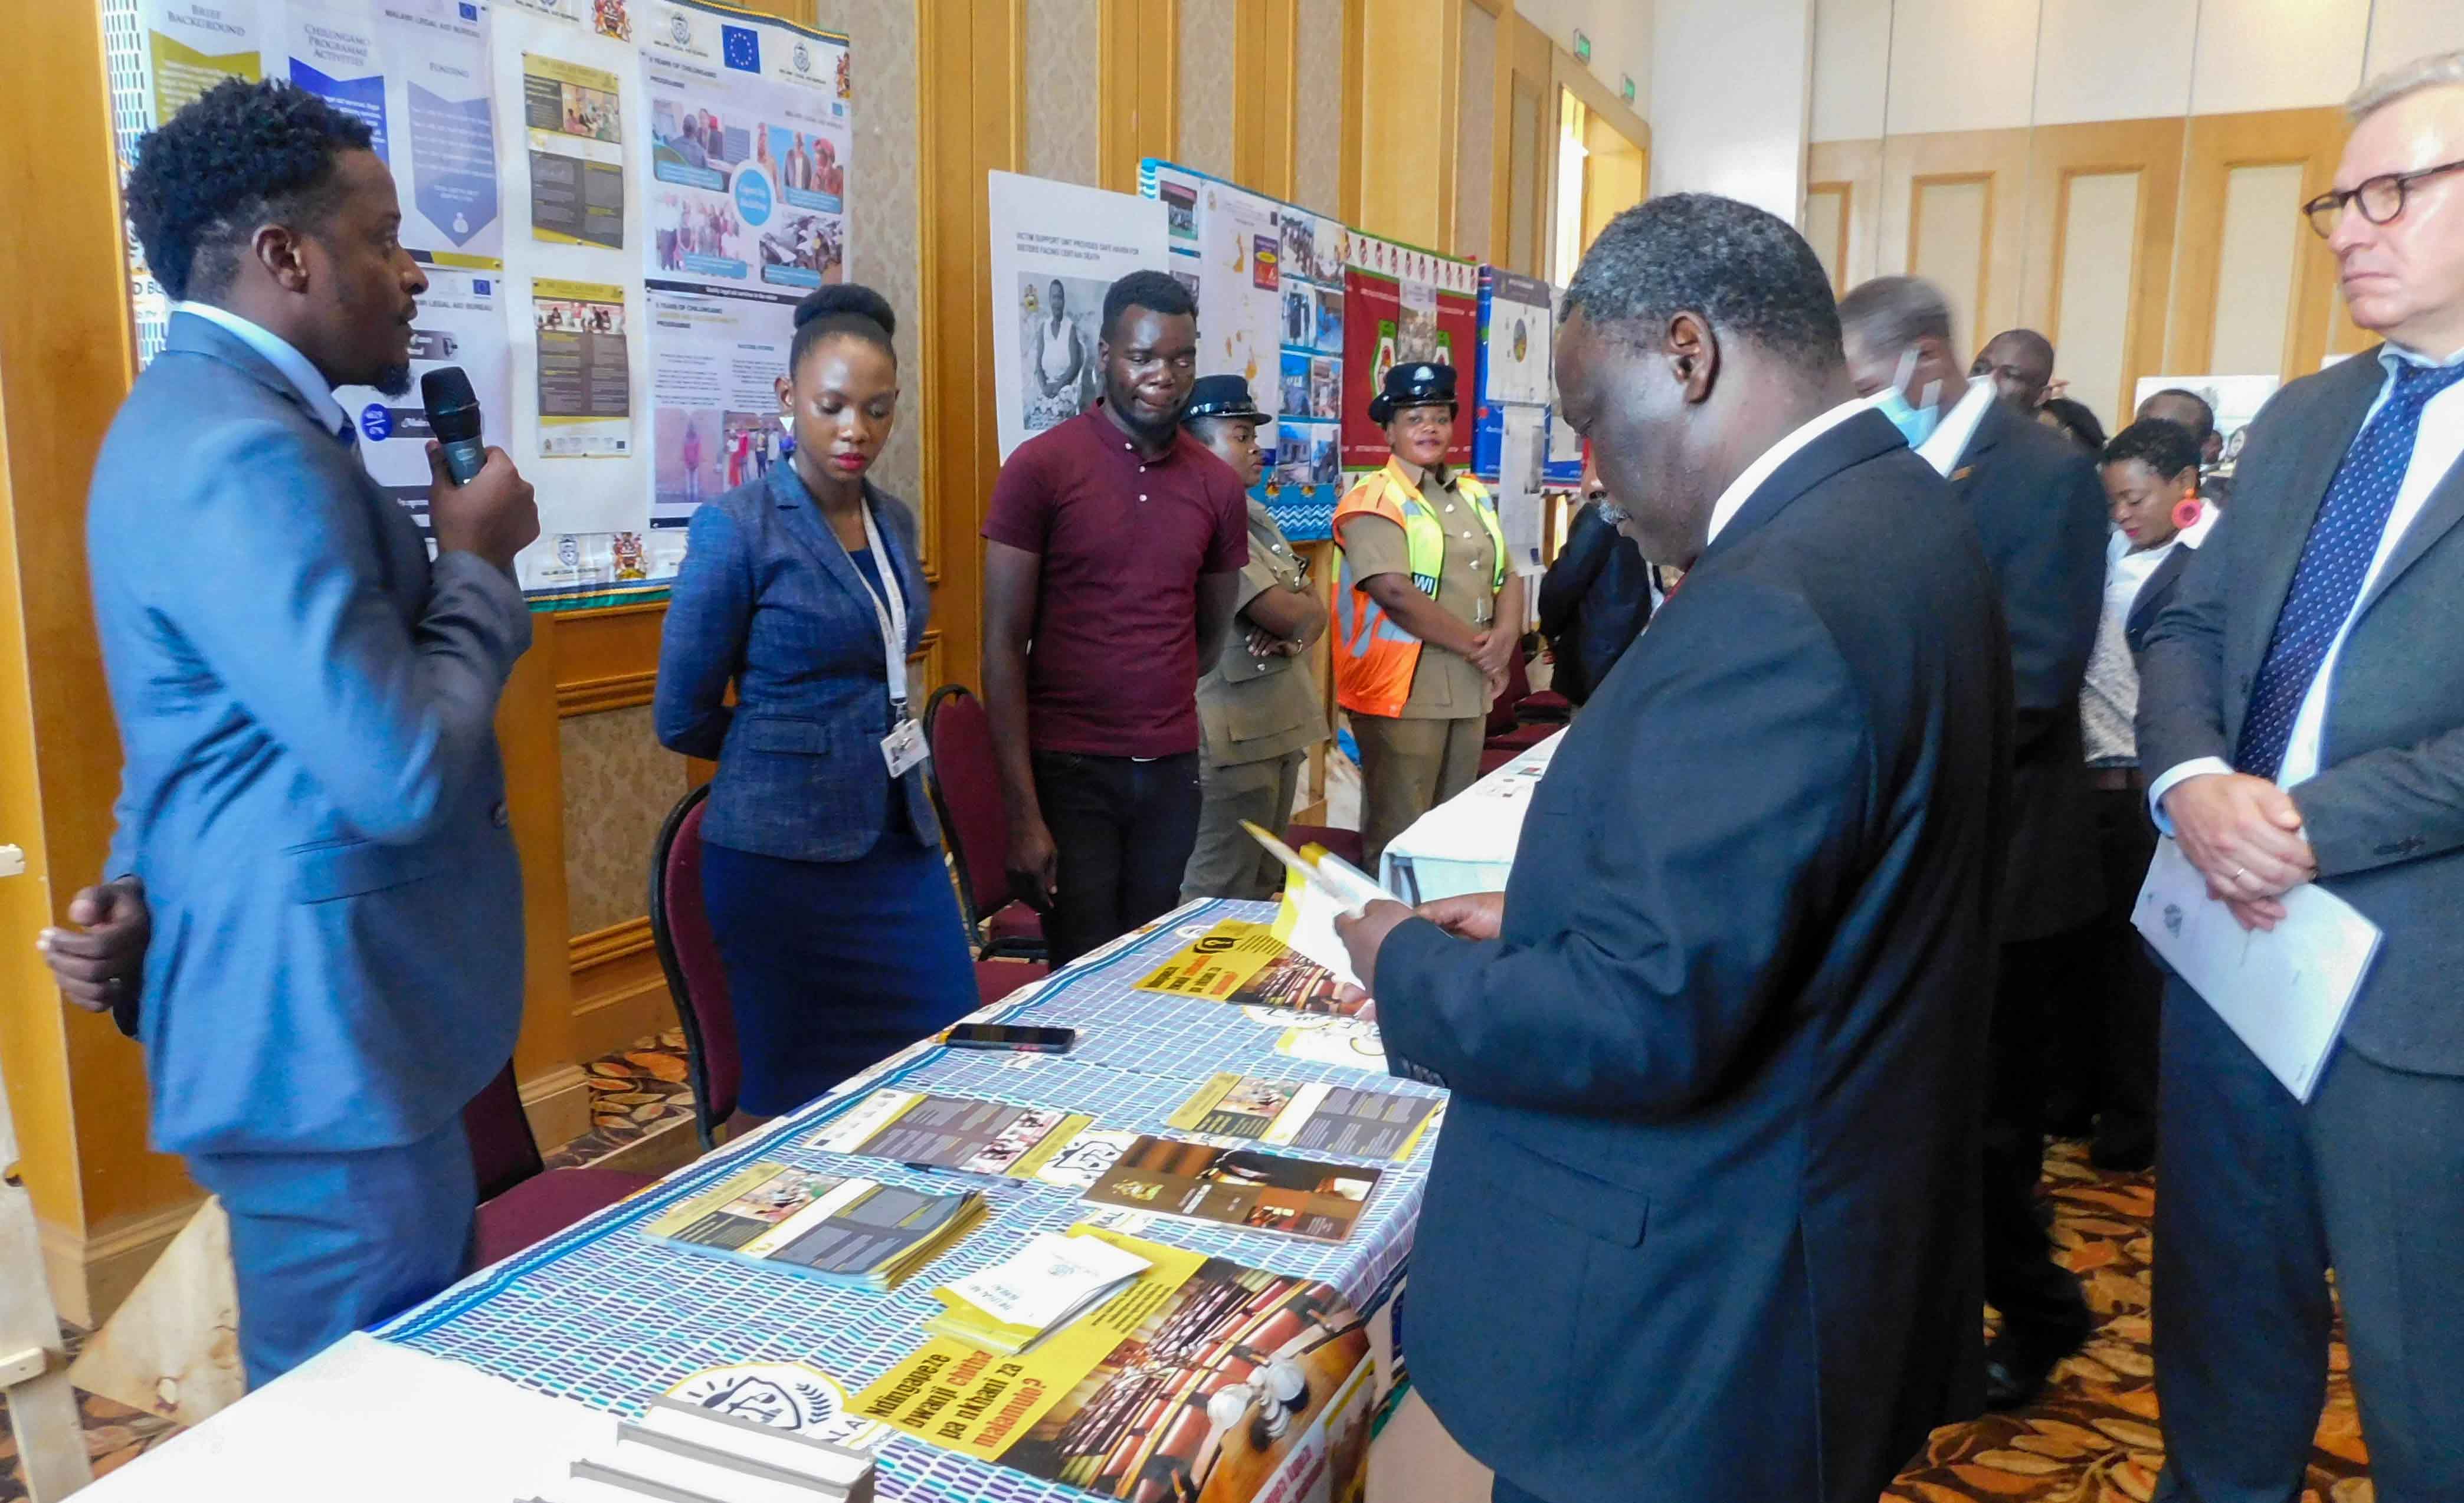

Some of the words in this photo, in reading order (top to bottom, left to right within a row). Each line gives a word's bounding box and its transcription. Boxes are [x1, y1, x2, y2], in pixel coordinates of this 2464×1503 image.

[863, 1353, 952, 1417] Ndingapeze
[900, 1385, 958, 1429] bwanji
[946, 1350, 994, 1387] chitha
[937, 1416, 967, 1440] pa
[956, 1377, 1010, 1421] nkhani
[996, 1363, 1024, 1378] za
[973, 1377, 1048, 1448] malamulo?
